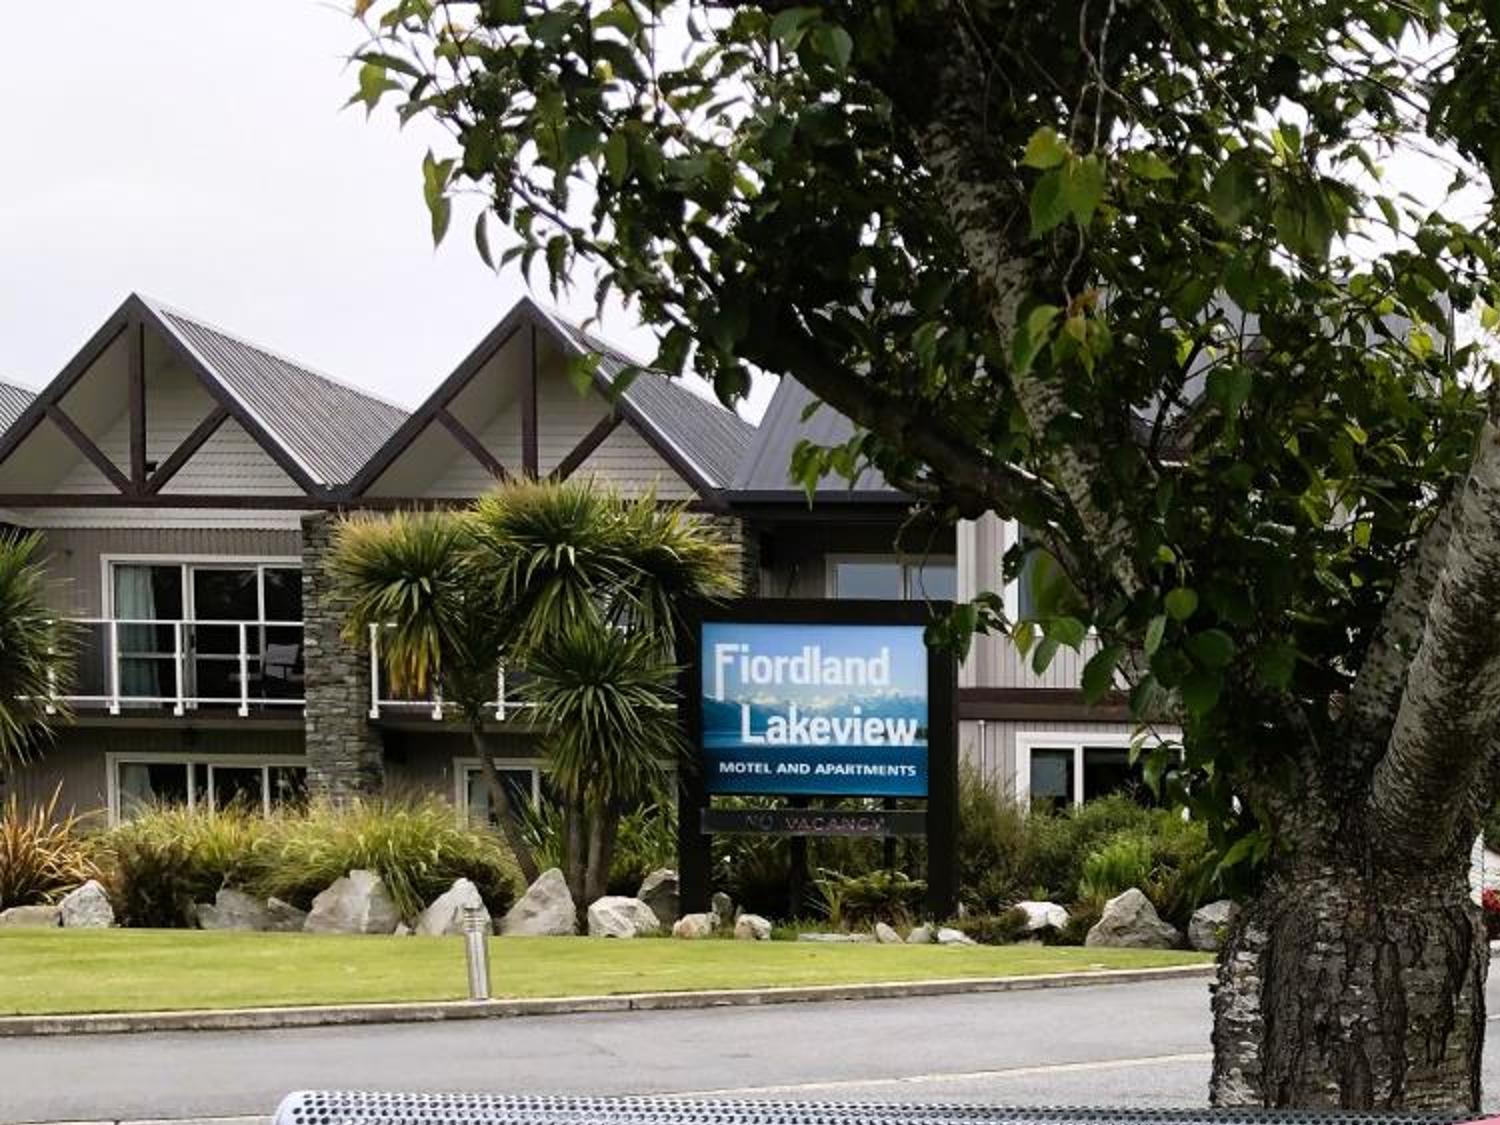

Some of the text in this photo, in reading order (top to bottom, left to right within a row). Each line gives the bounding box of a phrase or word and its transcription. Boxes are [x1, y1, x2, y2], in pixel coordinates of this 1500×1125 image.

[714, 643, 890, 702] Fiordland
[741, 702, 918, 746] Lakeview
[719, 761, 917, 777] MOTEL AND APARTMENTS
